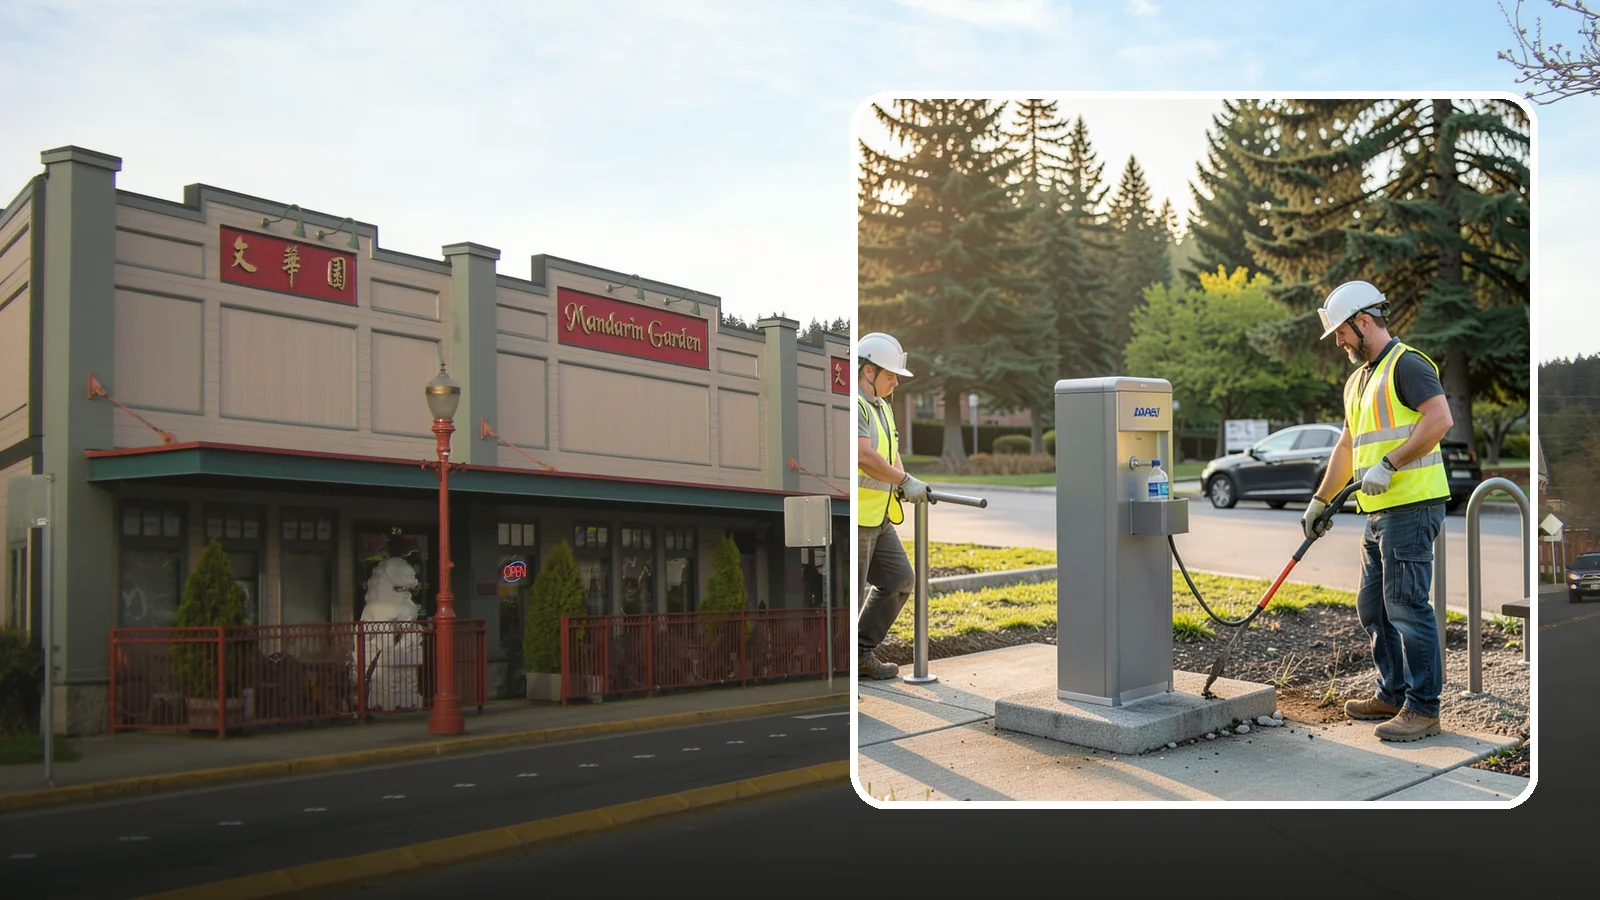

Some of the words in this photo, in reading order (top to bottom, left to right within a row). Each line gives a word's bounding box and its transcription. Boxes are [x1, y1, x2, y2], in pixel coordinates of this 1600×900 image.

[231, 236, 346, 290] 文華園
[564, 302, 644, 341] Mandarin
[648, 320, 702, 352] Garden
[503, 565, 526, 577] OPEN
